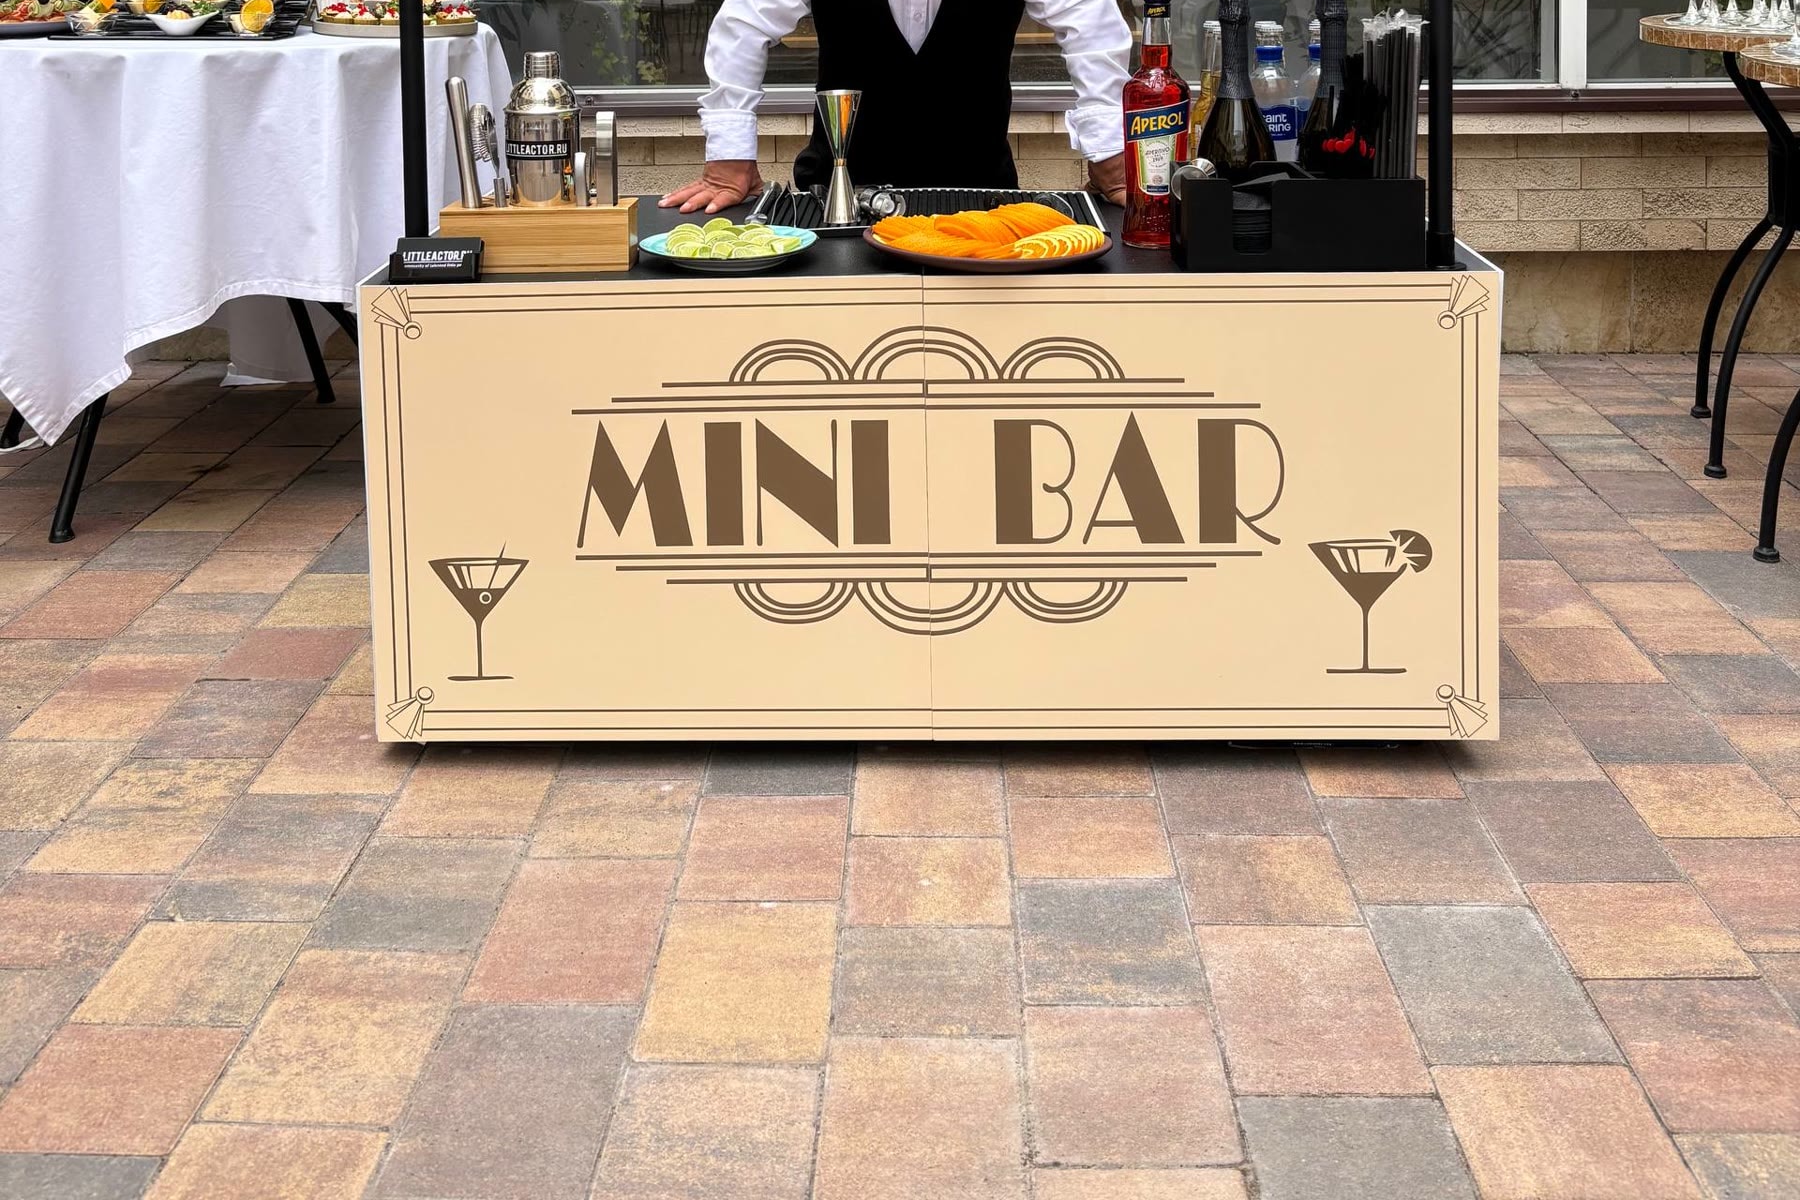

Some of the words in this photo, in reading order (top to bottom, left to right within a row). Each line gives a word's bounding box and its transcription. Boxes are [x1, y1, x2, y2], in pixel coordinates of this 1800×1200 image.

[1130, 111, 1184, 136] APEROL
[1263, 113, 1287, 123] aint
[576, 417, 892, 549] MINI
[993, 410, 1286, 546] BAR
